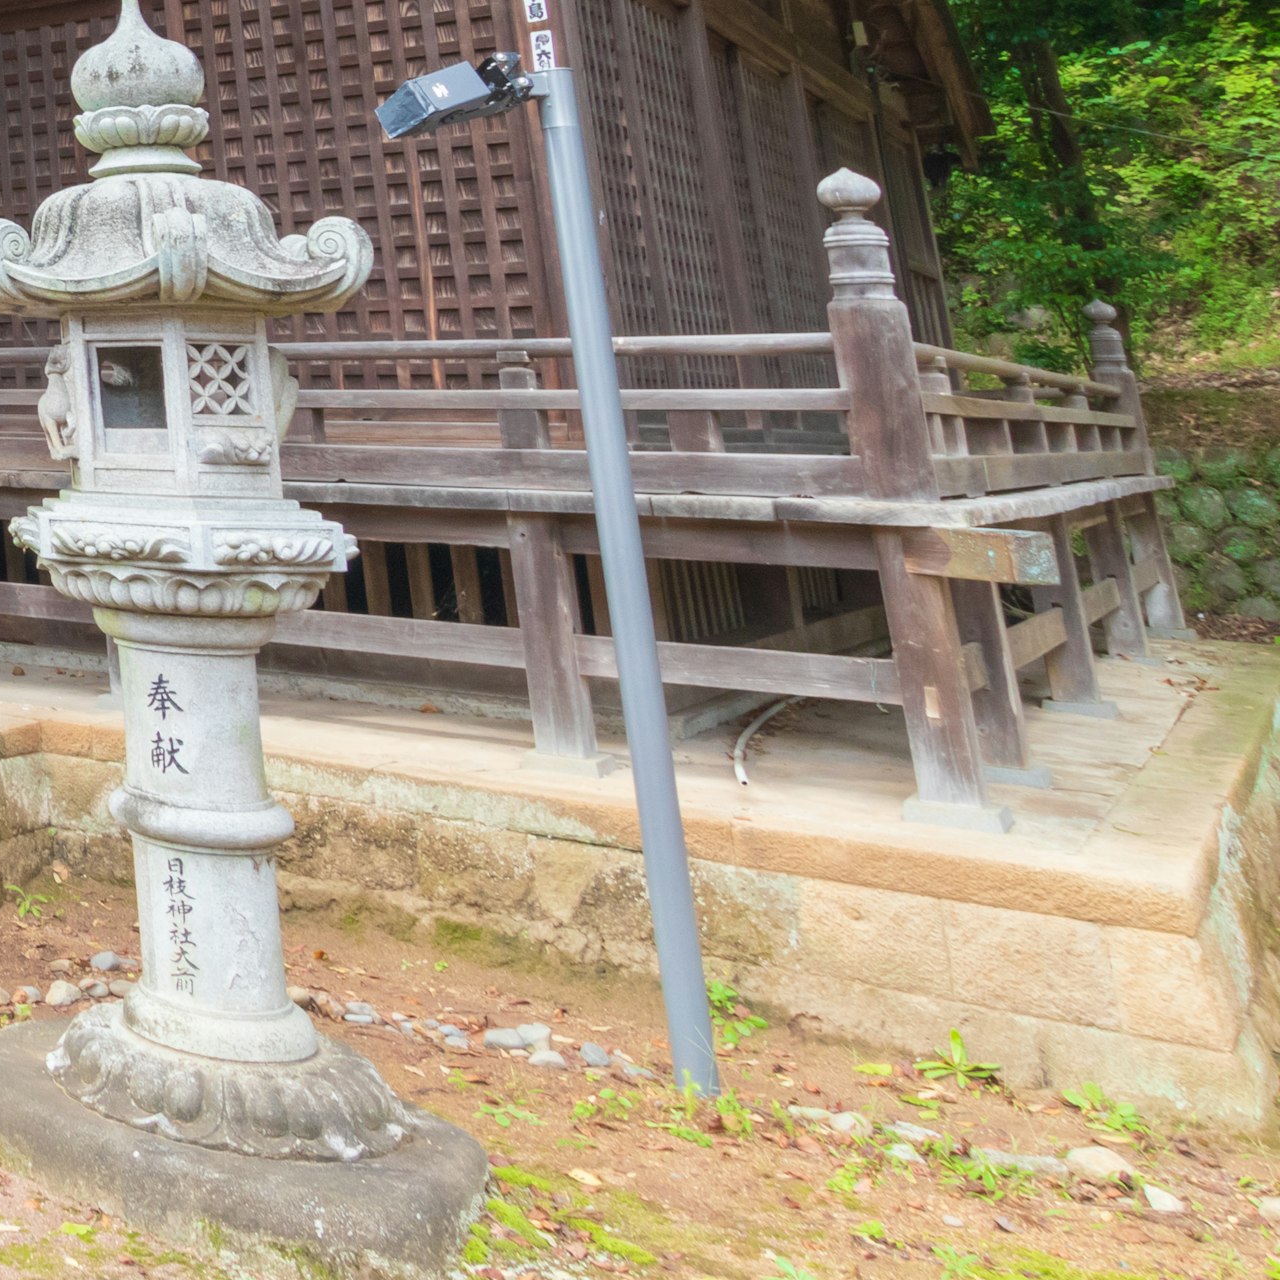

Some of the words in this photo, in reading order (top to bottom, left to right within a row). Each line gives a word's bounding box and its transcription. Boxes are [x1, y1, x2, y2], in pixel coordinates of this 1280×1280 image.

[146, 673, 190, 775] 奉献
[162, 857, 200, 996] 日枝神社大前
